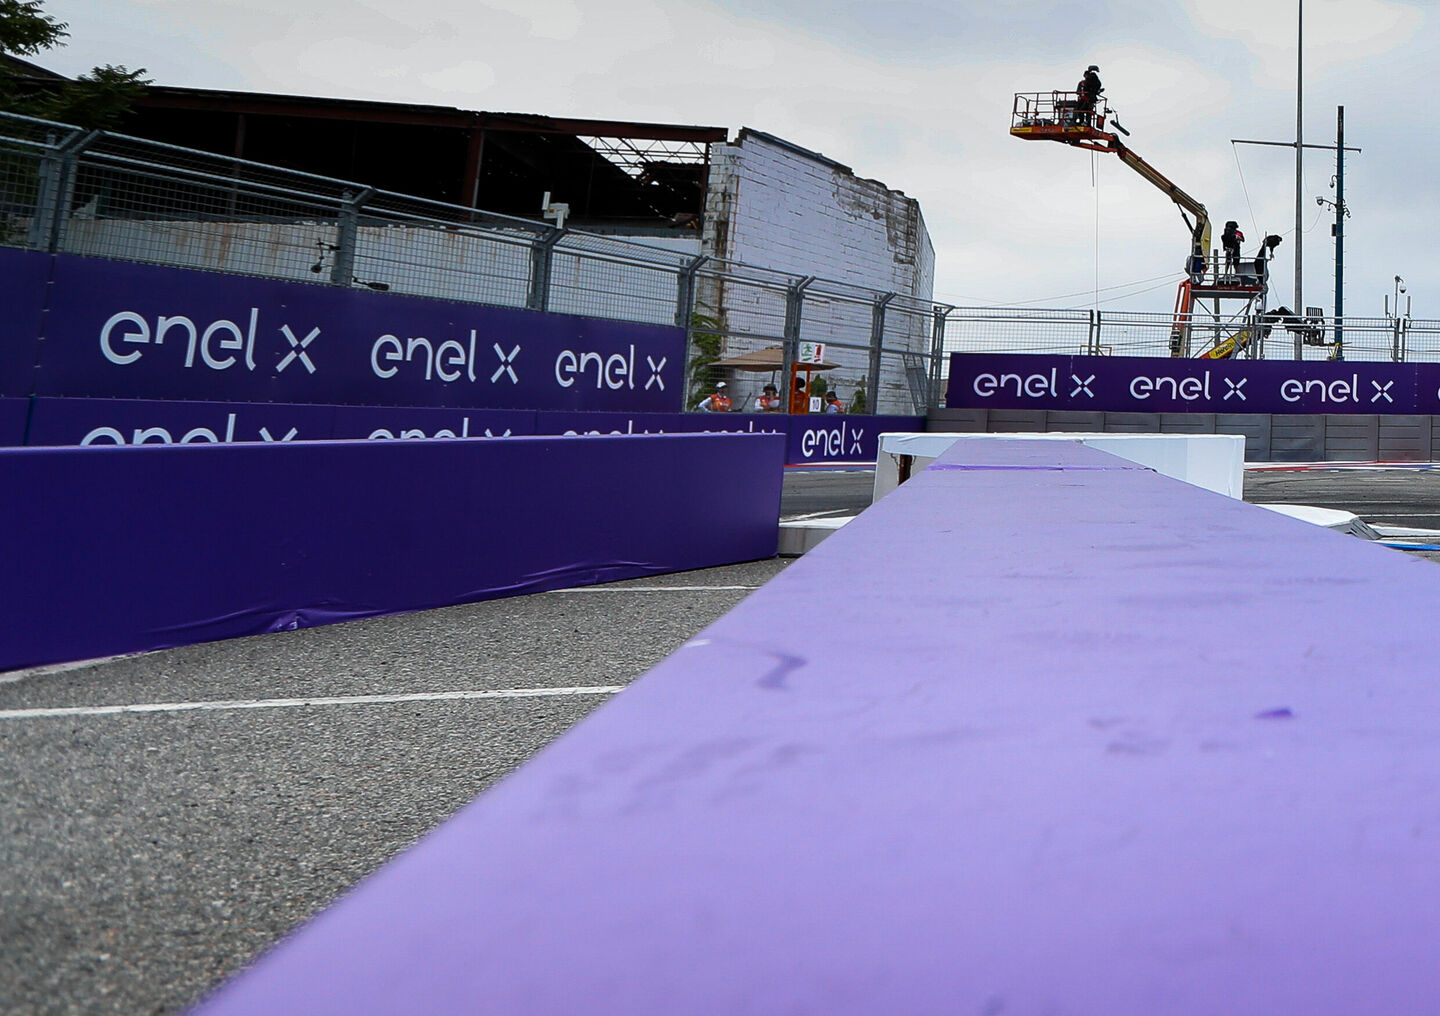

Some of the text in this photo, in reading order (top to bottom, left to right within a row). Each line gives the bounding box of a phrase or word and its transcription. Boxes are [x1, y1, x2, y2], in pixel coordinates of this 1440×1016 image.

[100, 307, 259, 372] enel
[371, 329, 477, 383] enel
[555, 344, 635, 390] enel
[973, 367, 1057, 398] enel
[1129, 370, 1211, 401] enel
[1280, 374, 1359, 403] enel
[802, 421, 846, 458] enel
